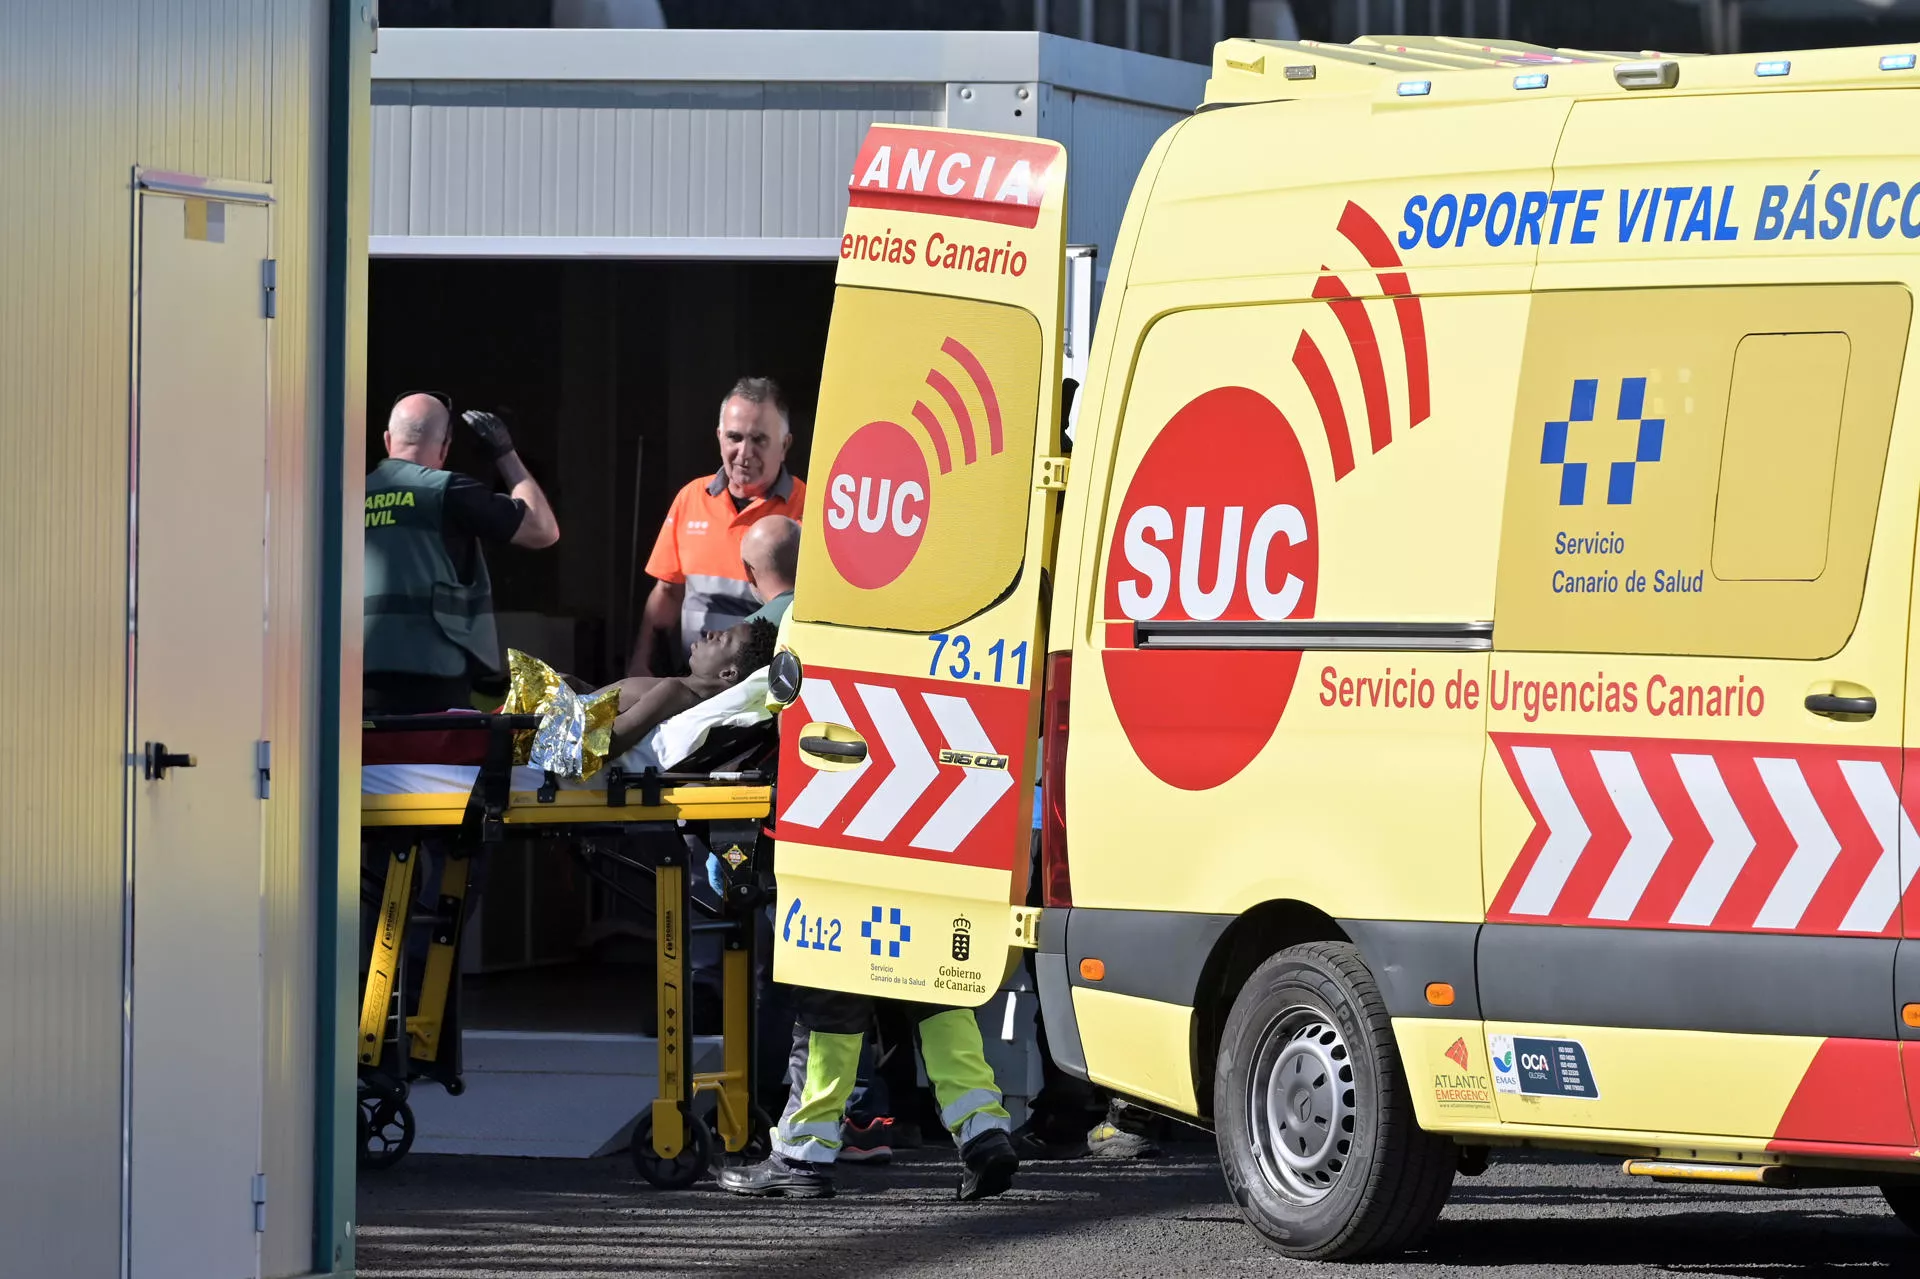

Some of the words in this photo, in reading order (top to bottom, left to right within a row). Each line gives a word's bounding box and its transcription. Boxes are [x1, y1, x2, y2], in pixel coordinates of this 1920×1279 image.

[849, 145, 1031, 205] ANCIA
[1398, 189, 1604, 250] SOPORTE
[1618, 184, 1739, 243] VITAL
[1754, 169, 1920, 240] BÁSICO
[840, 228, 917, 265] encias
[925, 232, 1027, 277] Canario
[827, 473, 924, 537] SUC
[1555, 531, 1625, 555] Servicio
[1117, 503, 1308, 621] SUC
[1552, 570, 1618, 593] Canario
[1625, 569, 1646, 593] de
[1653, 569, 1704, 593] Salud
[928, 633, 1027, 685] 73.11
[1319, 665, 1435, 709] Servicio
[1445, 668, 1479, 710] de
[1490, 669, 1638, 722] Urgencias
[1646, 674, 1765, 717] Canario
[939, 751, 973, 766] 316
[974, 755, 1007, 769] CDI
[870, 963, 894, 973] Servicio
[939, 965, 981, 980] Gobierno
[870, 973, 892, 983] Canario
[894, 976, 901, 984] de
[902, 977, 908, 985] la
[908, 977, 926, 987] Salud
[934, 978, 945, 989] de
[946, 980, 986, 994] Canarias
[1521, 1053, 1549, 1071] OCA
[1435, 1074, 1487, 1089] ATLANTIC
[1496, 1076, 1517, 1085] EMAS
[1435, 1089, 1489, 1101] EMERGENCY
